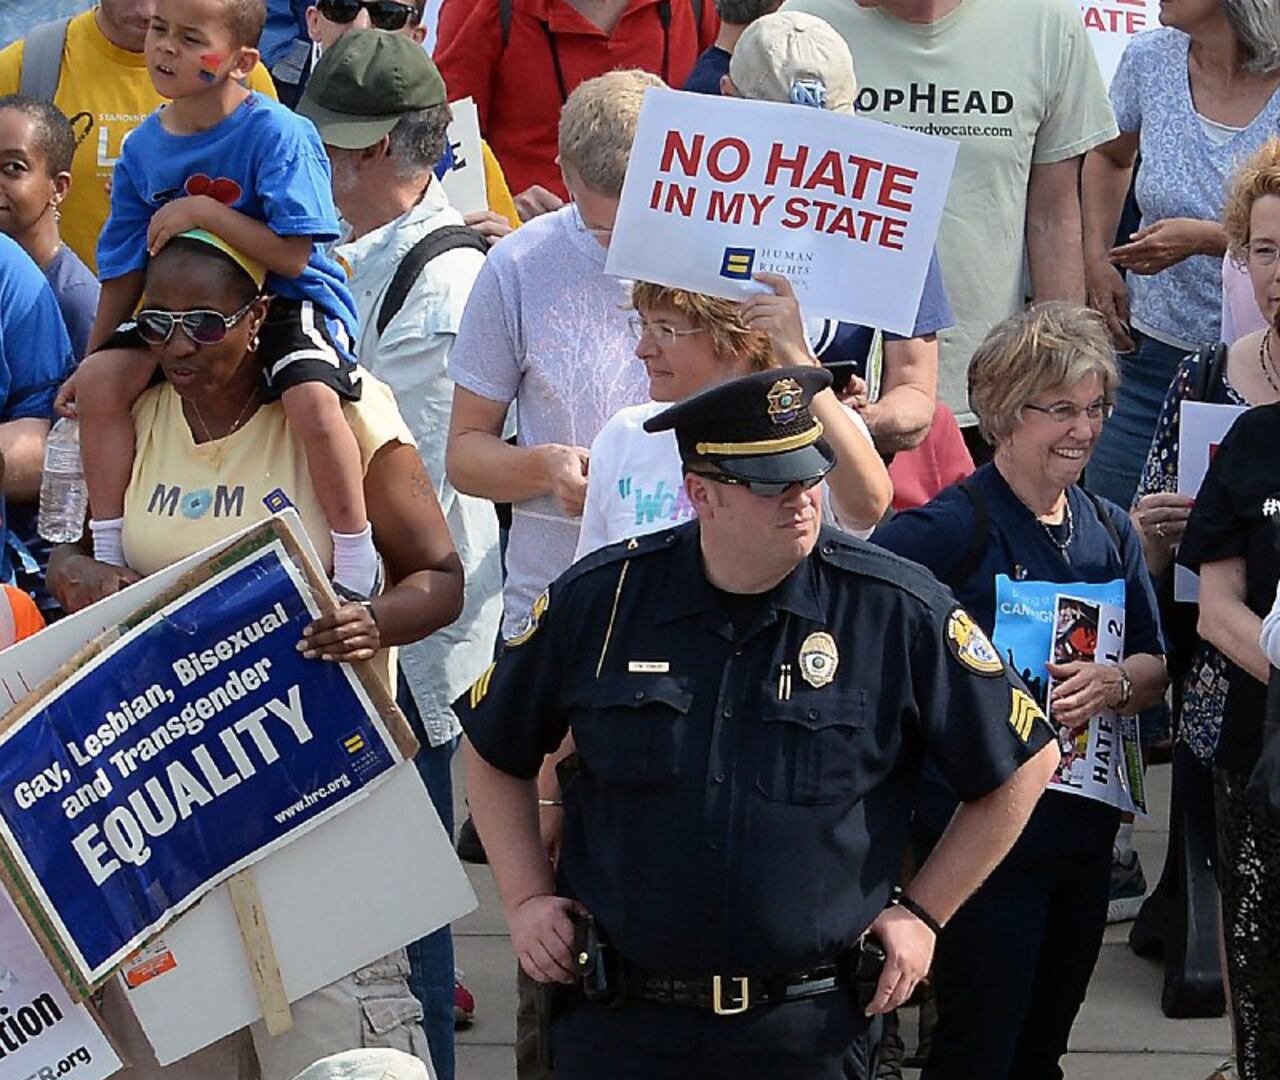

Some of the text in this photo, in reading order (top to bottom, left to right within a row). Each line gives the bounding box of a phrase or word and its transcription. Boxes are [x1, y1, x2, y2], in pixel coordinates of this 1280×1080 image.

[1084, 7, 1146, 34] ATE
[854, 83, 1015, 115] OPHEAD
[660, 130, 919, 213] NO HATE
[649, 180, 908, 251] IN MY STATE
[1108, 619, 1123, 637] 2
[13, 603, 290, 810] Gay, Lesbian, Bisexual
[61, 657, 273, 820] and Transgender
[71, 684, 314, 887] EQUALITY
[274, 773, 352, 823] www.hrc.org
